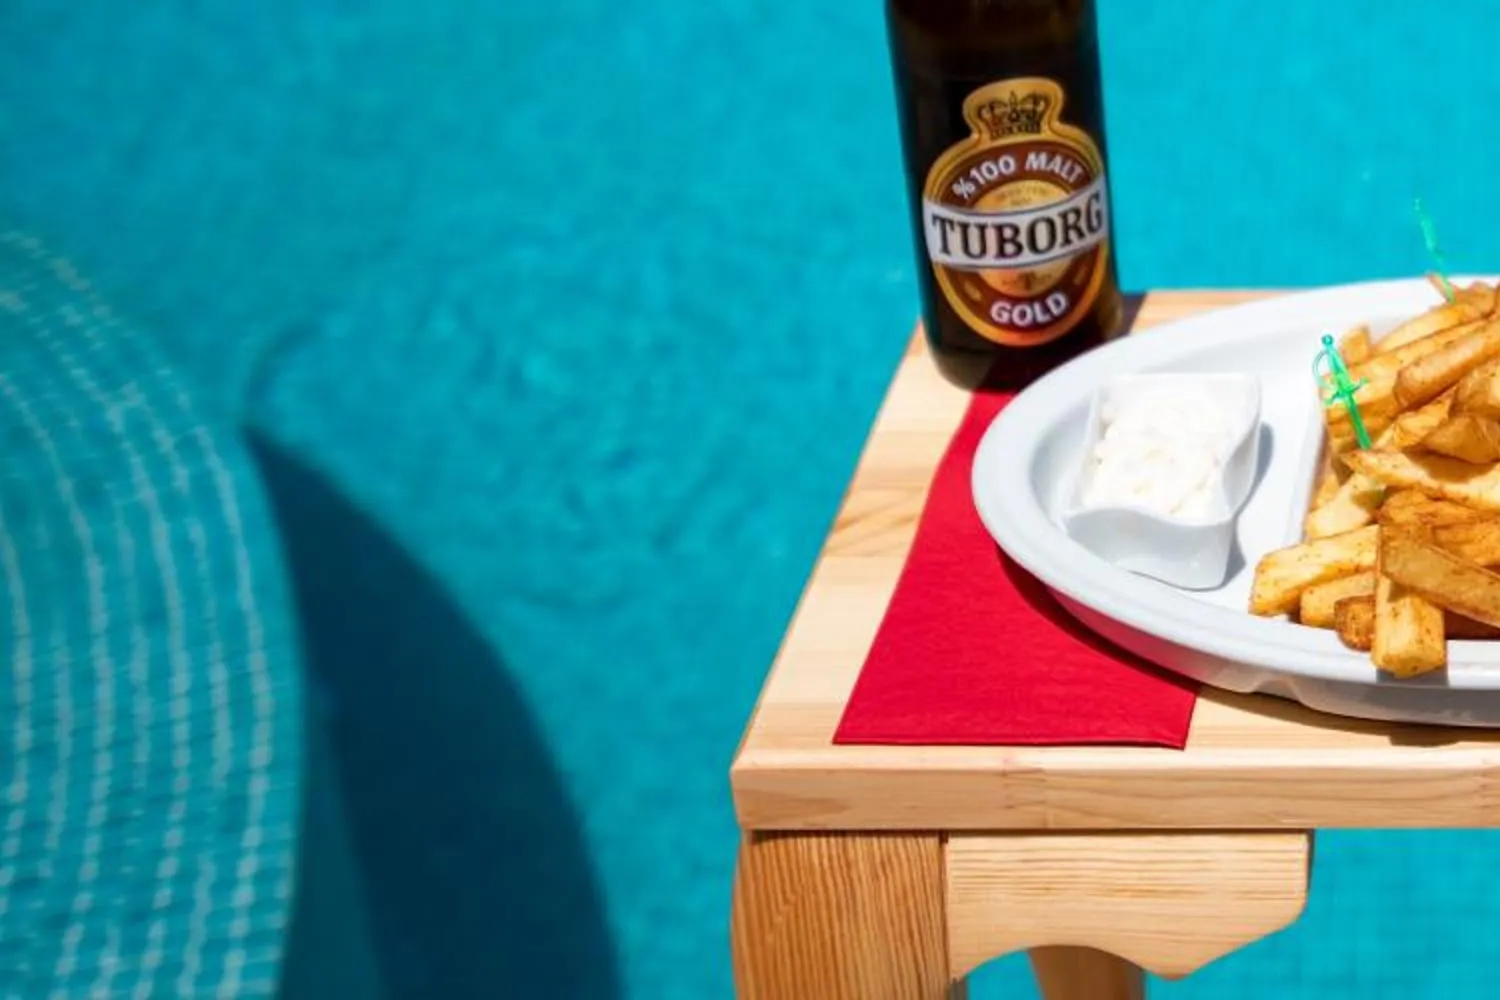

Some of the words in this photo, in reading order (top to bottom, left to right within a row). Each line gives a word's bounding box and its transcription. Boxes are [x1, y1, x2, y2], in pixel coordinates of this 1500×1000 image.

[952, 155, 1016, 199] %100
[1025, 152, 1083, 184] MALT
[931, 192, 1103, 259] TUBORG
[990, 291, 1069, 327] GOLD
